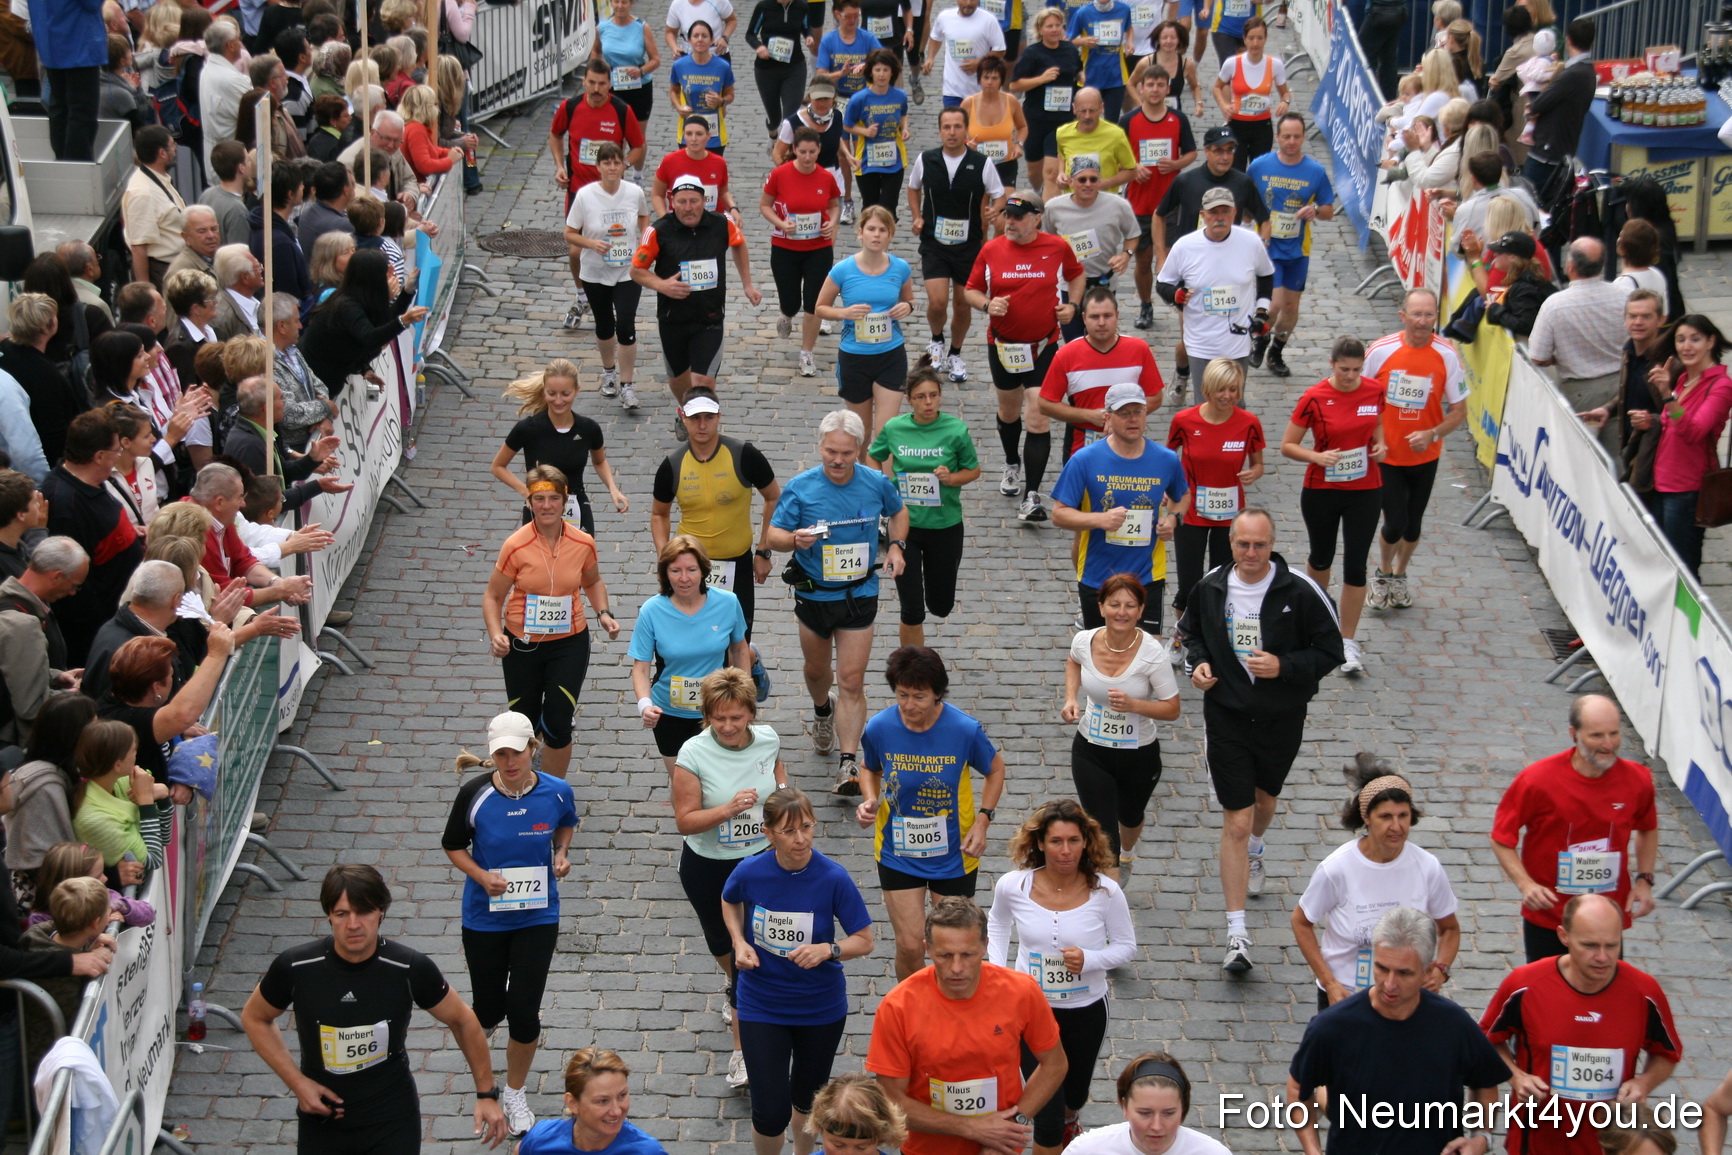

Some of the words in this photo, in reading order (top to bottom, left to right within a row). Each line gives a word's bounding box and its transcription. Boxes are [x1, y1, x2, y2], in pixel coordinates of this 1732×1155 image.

[1102, 30, 1118, 38] 3412
[1053, 96, 1069, 104] 3097
[1248, 101, 1265, 109] 2731
[876, 151, 893, 159] 3462
[986, 149, 1004, 158] 3286
[1149, 149, 1168, 157] 3636
[798, 222, 818, 231] 3567
[1280, 222, 1296, 231] 707
[944, 228, 964, 237] 3463
[1075, 241, 1093, 252] 883
[612, 249, 633, 257] 3082
[692, 270, 714, 280] 3083
[1002, 271, 1046, 279] Röthenbach
[1214, 296, 1236, 306] 3149
[869, 324, 887, 334] 813
[1008, 354, 1026, 364] 183
[1399, 387, 1424, 398] 3659
[1357, 405, 1378, 413] JURA
[1222, 441, 1246, 449] JURA
[898, 445, 943, 458] Sinupret
[1338, 460, 1362, 471] 3382
[908, 475, 930, 483] Cornelia
[1096, 475, 1107, 483] 10.
[1108, 475, 1161, 485] NEUMARKTER
[910, 485, 935, 495] 2754
[1106, 483, 1151, 492] STADTLAUF
[1208, 490, 1227, 498] Andrea
[1208, 500, 1234, 509] 3383
[1127, 524, 1141, 534] 24
[835, 547, 854, 556] Bernd
[840, 558, 862, 569] 214
[539, 598, 562, 608] Melanie
[539, 610, 567, 621] 2322
[1236, 622, 1258, 631] Johann
[1103, 711, 1126, 721] Claudia
[1103, 722, 1133, 735] 2510
[894, 753, 956, 765] NEUMARKTER
[891, 761, 944, 774] STADTLAUF
[916, 797, 952, 806] 20.09.2009
[906, 821, 938, 830] Rosmarie
[908, 831, 941, 844] 3005
[1575, 857, 1600, 865] Walter
[1575, 868, 1612, 880] 2569
[506, 880, 541, 894] 3772
[768, 914, 793, 926] Angela
[768, 928, 805, 943] 3380
[1045, 958, 1065, 967] Manu
[1574, 1015, 1594, 1023] JAKO
[338, 1030, 374, 1041] Norbert
[346, 1041, 378, 1058] 566
[1571, 1052, 1611, 1064] Wolfgang
[1571, 1067, 1614, 1082] 3064
[947, 1084, 971, 1094] Klaus
[954, 1096, 986, 1111] 320
